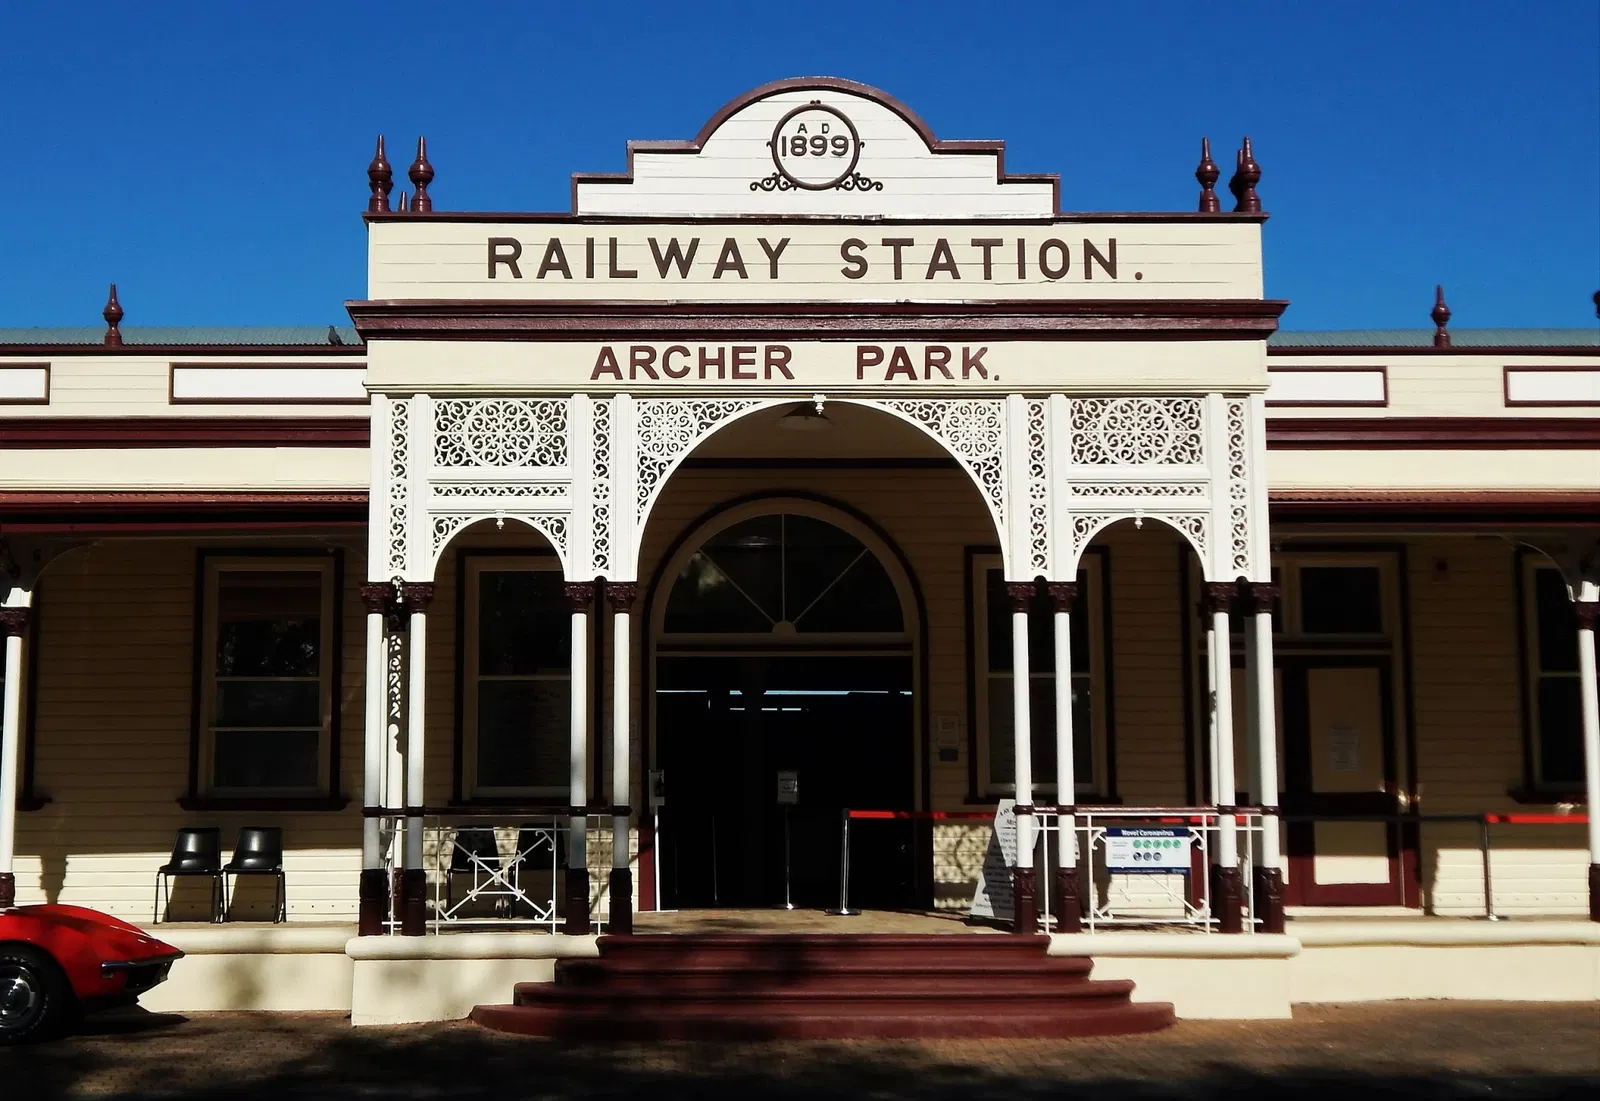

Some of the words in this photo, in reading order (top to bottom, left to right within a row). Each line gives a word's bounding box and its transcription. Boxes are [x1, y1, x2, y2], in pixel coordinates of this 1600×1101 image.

[797, 123, 808, 134] A
[821, 123, 830, 134] D
[781, 135, 849, 157] 1899
[488, 238, 790, 279] RAILWAY
[841, 238, 1142, 281] STATION.
[590, 345, 795, 380] ARCHER
[856, 345, 1000, 381] PARK.
[1139, 829, 1174, 837] Coronavirus
